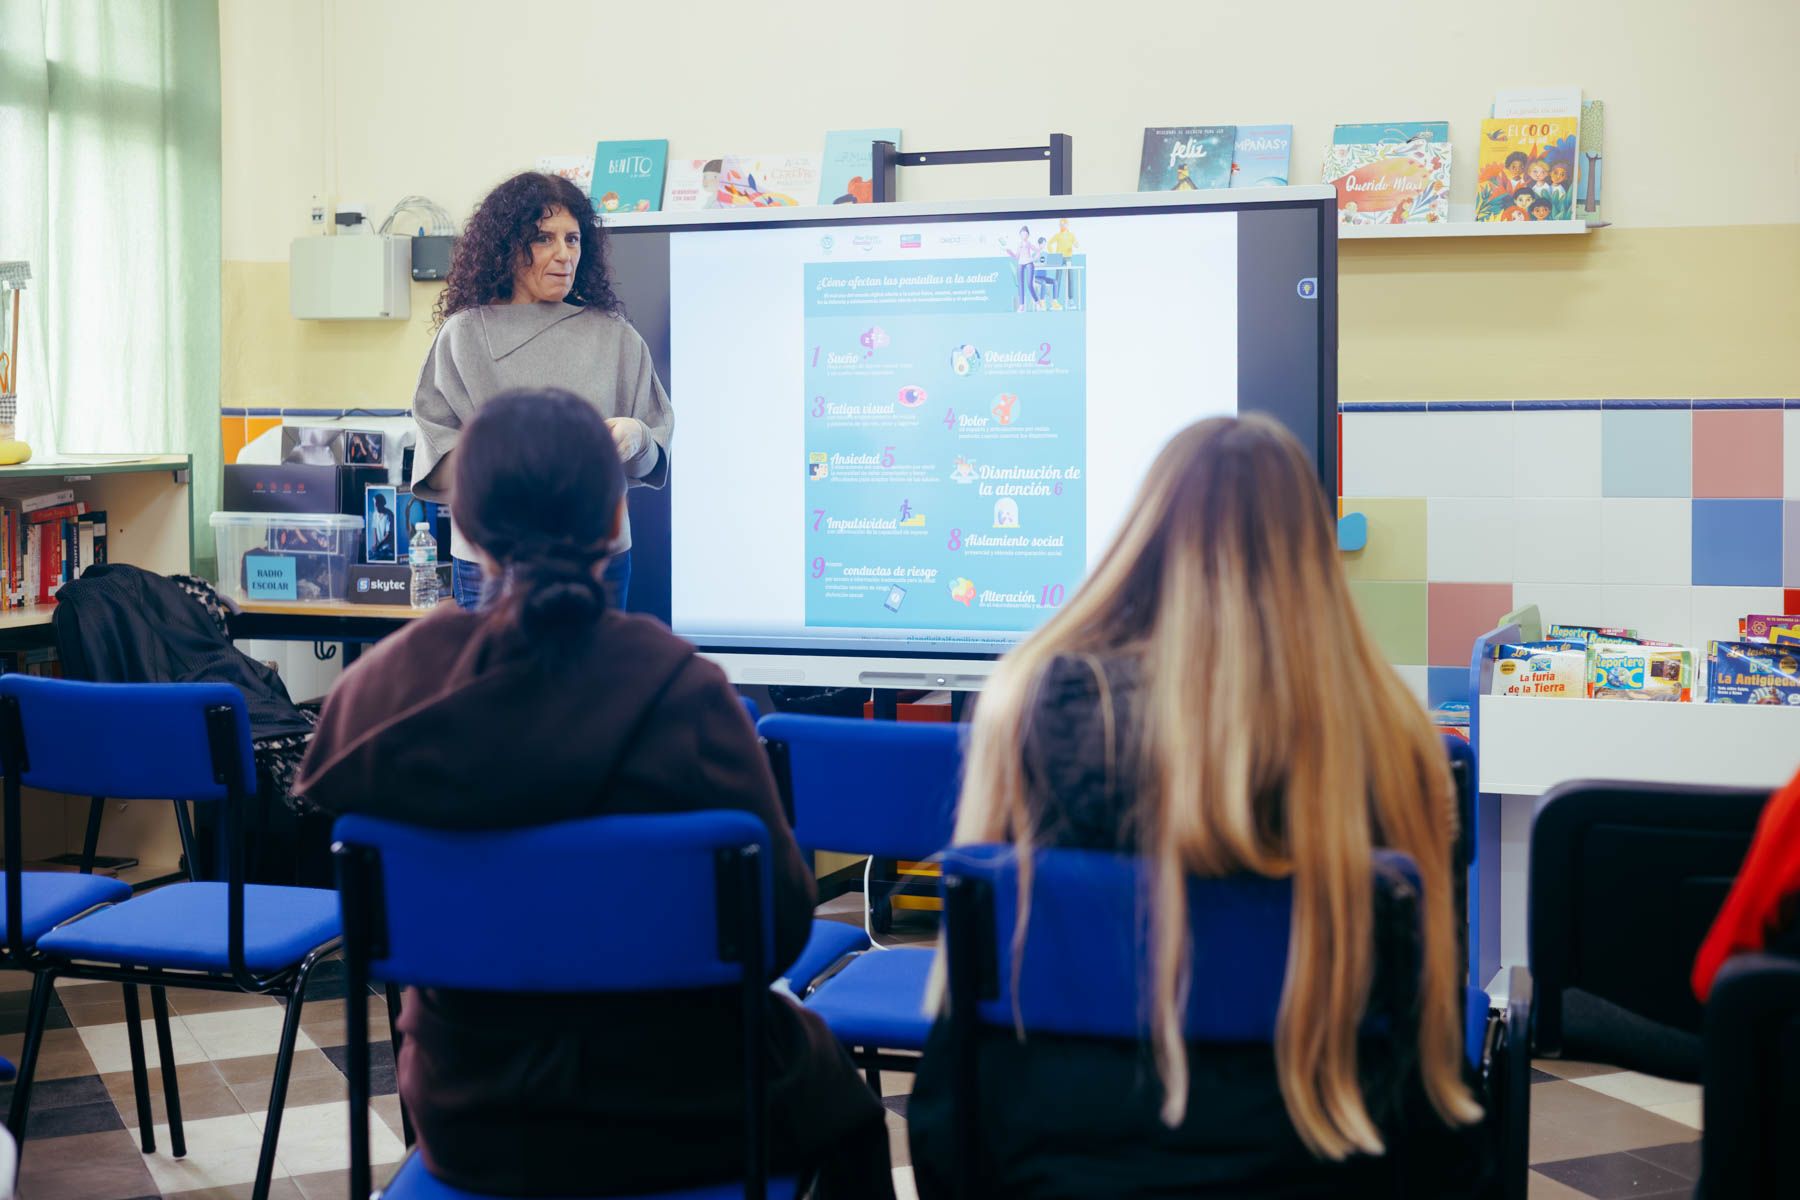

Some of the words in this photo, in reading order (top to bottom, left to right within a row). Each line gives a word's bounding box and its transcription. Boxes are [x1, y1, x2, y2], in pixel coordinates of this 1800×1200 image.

[1170, 138, 1207, 167] feliz
[609, 156, 653, 174] BENITO
[816, 278, 847, 290] ¿Cómo
[848, 276, 880, 289] afectan
[884, 276, 897, 286] las
[898, 274, 943, 288] pantallas
[954, 274, 964, 283] la
[966, 272, 999, 283] salud?
[812, 346, 820, 368] 1
[827, 352, 858, 364] Sueño
[984, 351, 1036, 362] Obesidad
[1037, 342, 1052, 365] 2
[812, 396, 825, 417] 3
[827, 402, 861, 417] Fatiga
[863, 402, 894, 414] visual
[944, 408, 956, 431] 4
[958, 414, 990, 426] Dolor
[831, 452, 880, 464] Ansiedad
[881, 446, 896, 468] 5
[978, 464, 1062, 480] Disminución
[1064, 465, 1081, 479] de
[978, 482, 992, 496] la
[995, 481, 1051, 496] atención
[1054, 480, 1063, 496] 6
[813, 509, 826, 532] 7
[826, 516, 897, 531] Impulsividad
[947, 528, 961, 552] 8
[964, 534, 1029, 546] Aislamiento
[1031, 535, 1064, 546] social
[257, 569, 282, 577] RADIO
[812, 556, 825, 578] 9
[843, 565, 891, 576] conductas
[893, 565, 906, 576] de
[907, 566, 938, 580] riesgo
[252, 582, 289, 591] ESCOLAR
[371, 579, 405, 592] skytec
[979, 590, 1036, 602] Alteración
[1040, 583, 1064, 608] 10
[1532, 672, 1556, 681] furia
[1718, 673, 1731, 684] La
[1508, 685, 1519, 693] de
[1534, 683, 1565, 693] Tierra
